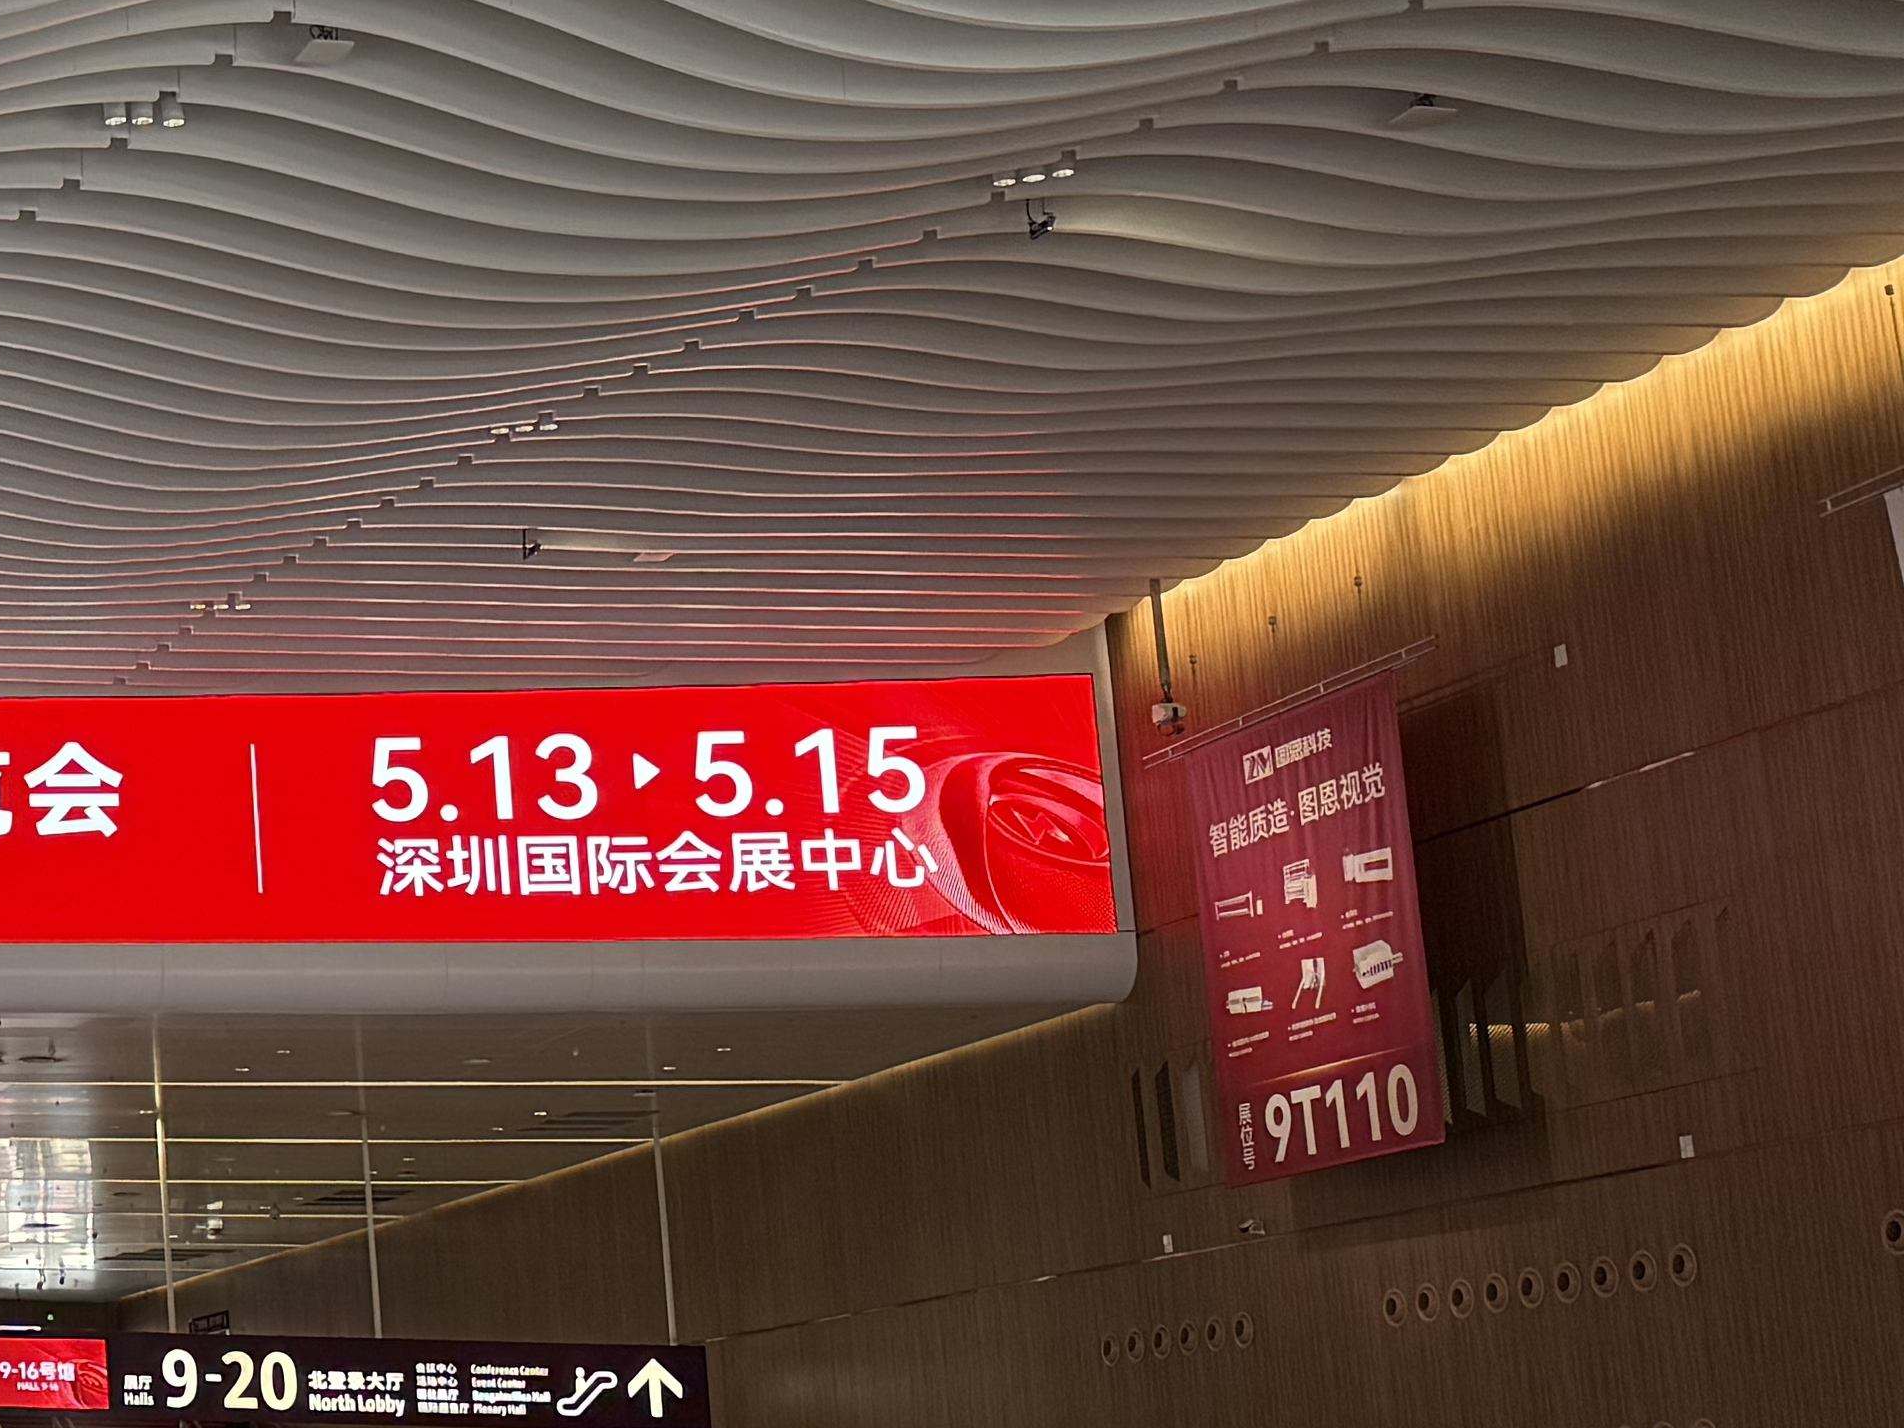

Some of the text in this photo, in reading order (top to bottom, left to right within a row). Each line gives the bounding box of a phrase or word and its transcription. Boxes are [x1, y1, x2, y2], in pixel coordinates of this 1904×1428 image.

[372, 726, 926, 823] 5.13 5.15
[377, 828, 940, 895] 深圳国际会展中心
[1265, 1064, 1418, 1163] 9T110
[124, 1391, 154, 1406] Halls
[162, 1348, 298, 1411] 9-20
[309, 1394, 355, 1412] North
[358, 1394, 405, 1417] Lobby
